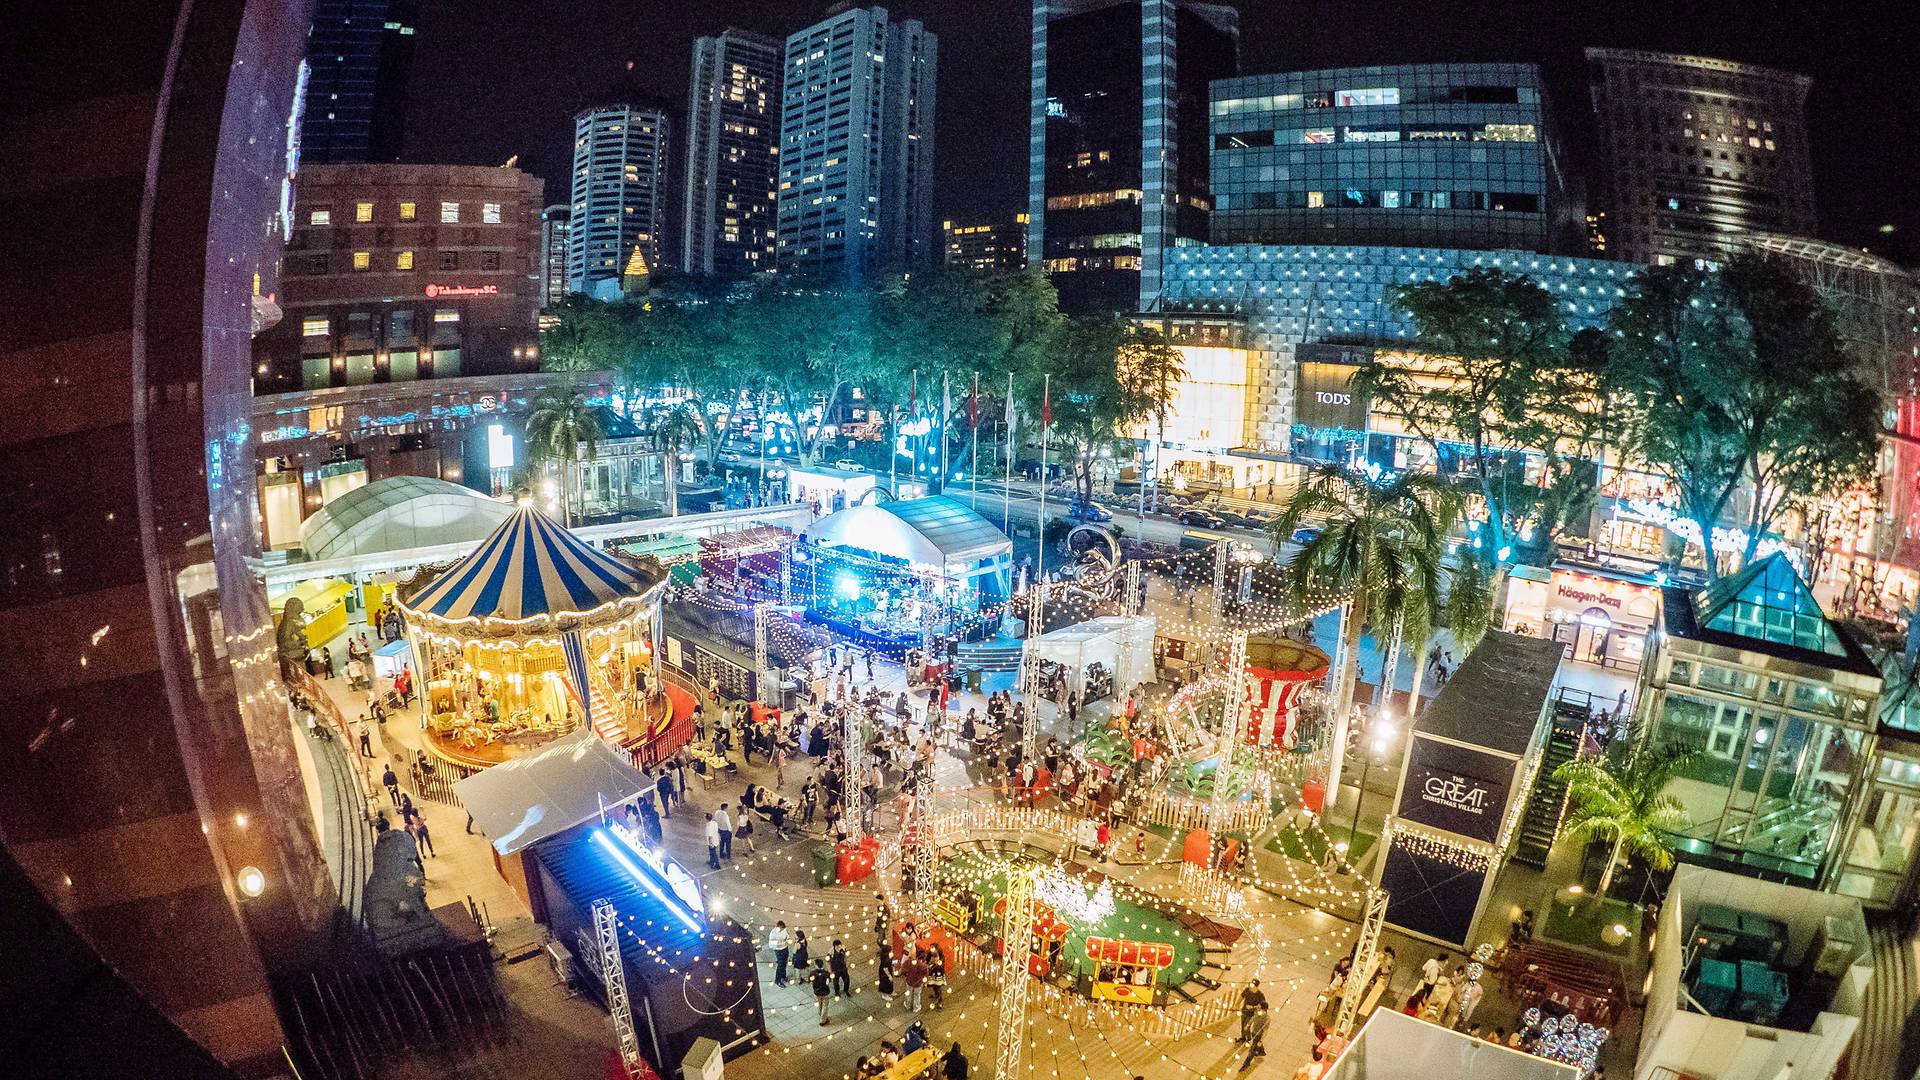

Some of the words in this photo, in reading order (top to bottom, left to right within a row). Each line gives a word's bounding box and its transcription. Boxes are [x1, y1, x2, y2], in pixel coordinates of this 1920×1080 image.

[1315, 391, 1351, 405] TOD'S
[1452, 775, 1465, 784] THE
[1425, 777, 1488, 808] GREAT
[1422, 794, 1457, 808] CHRISTMAS
[1458, 803, 1483, 815] VILLAGE
